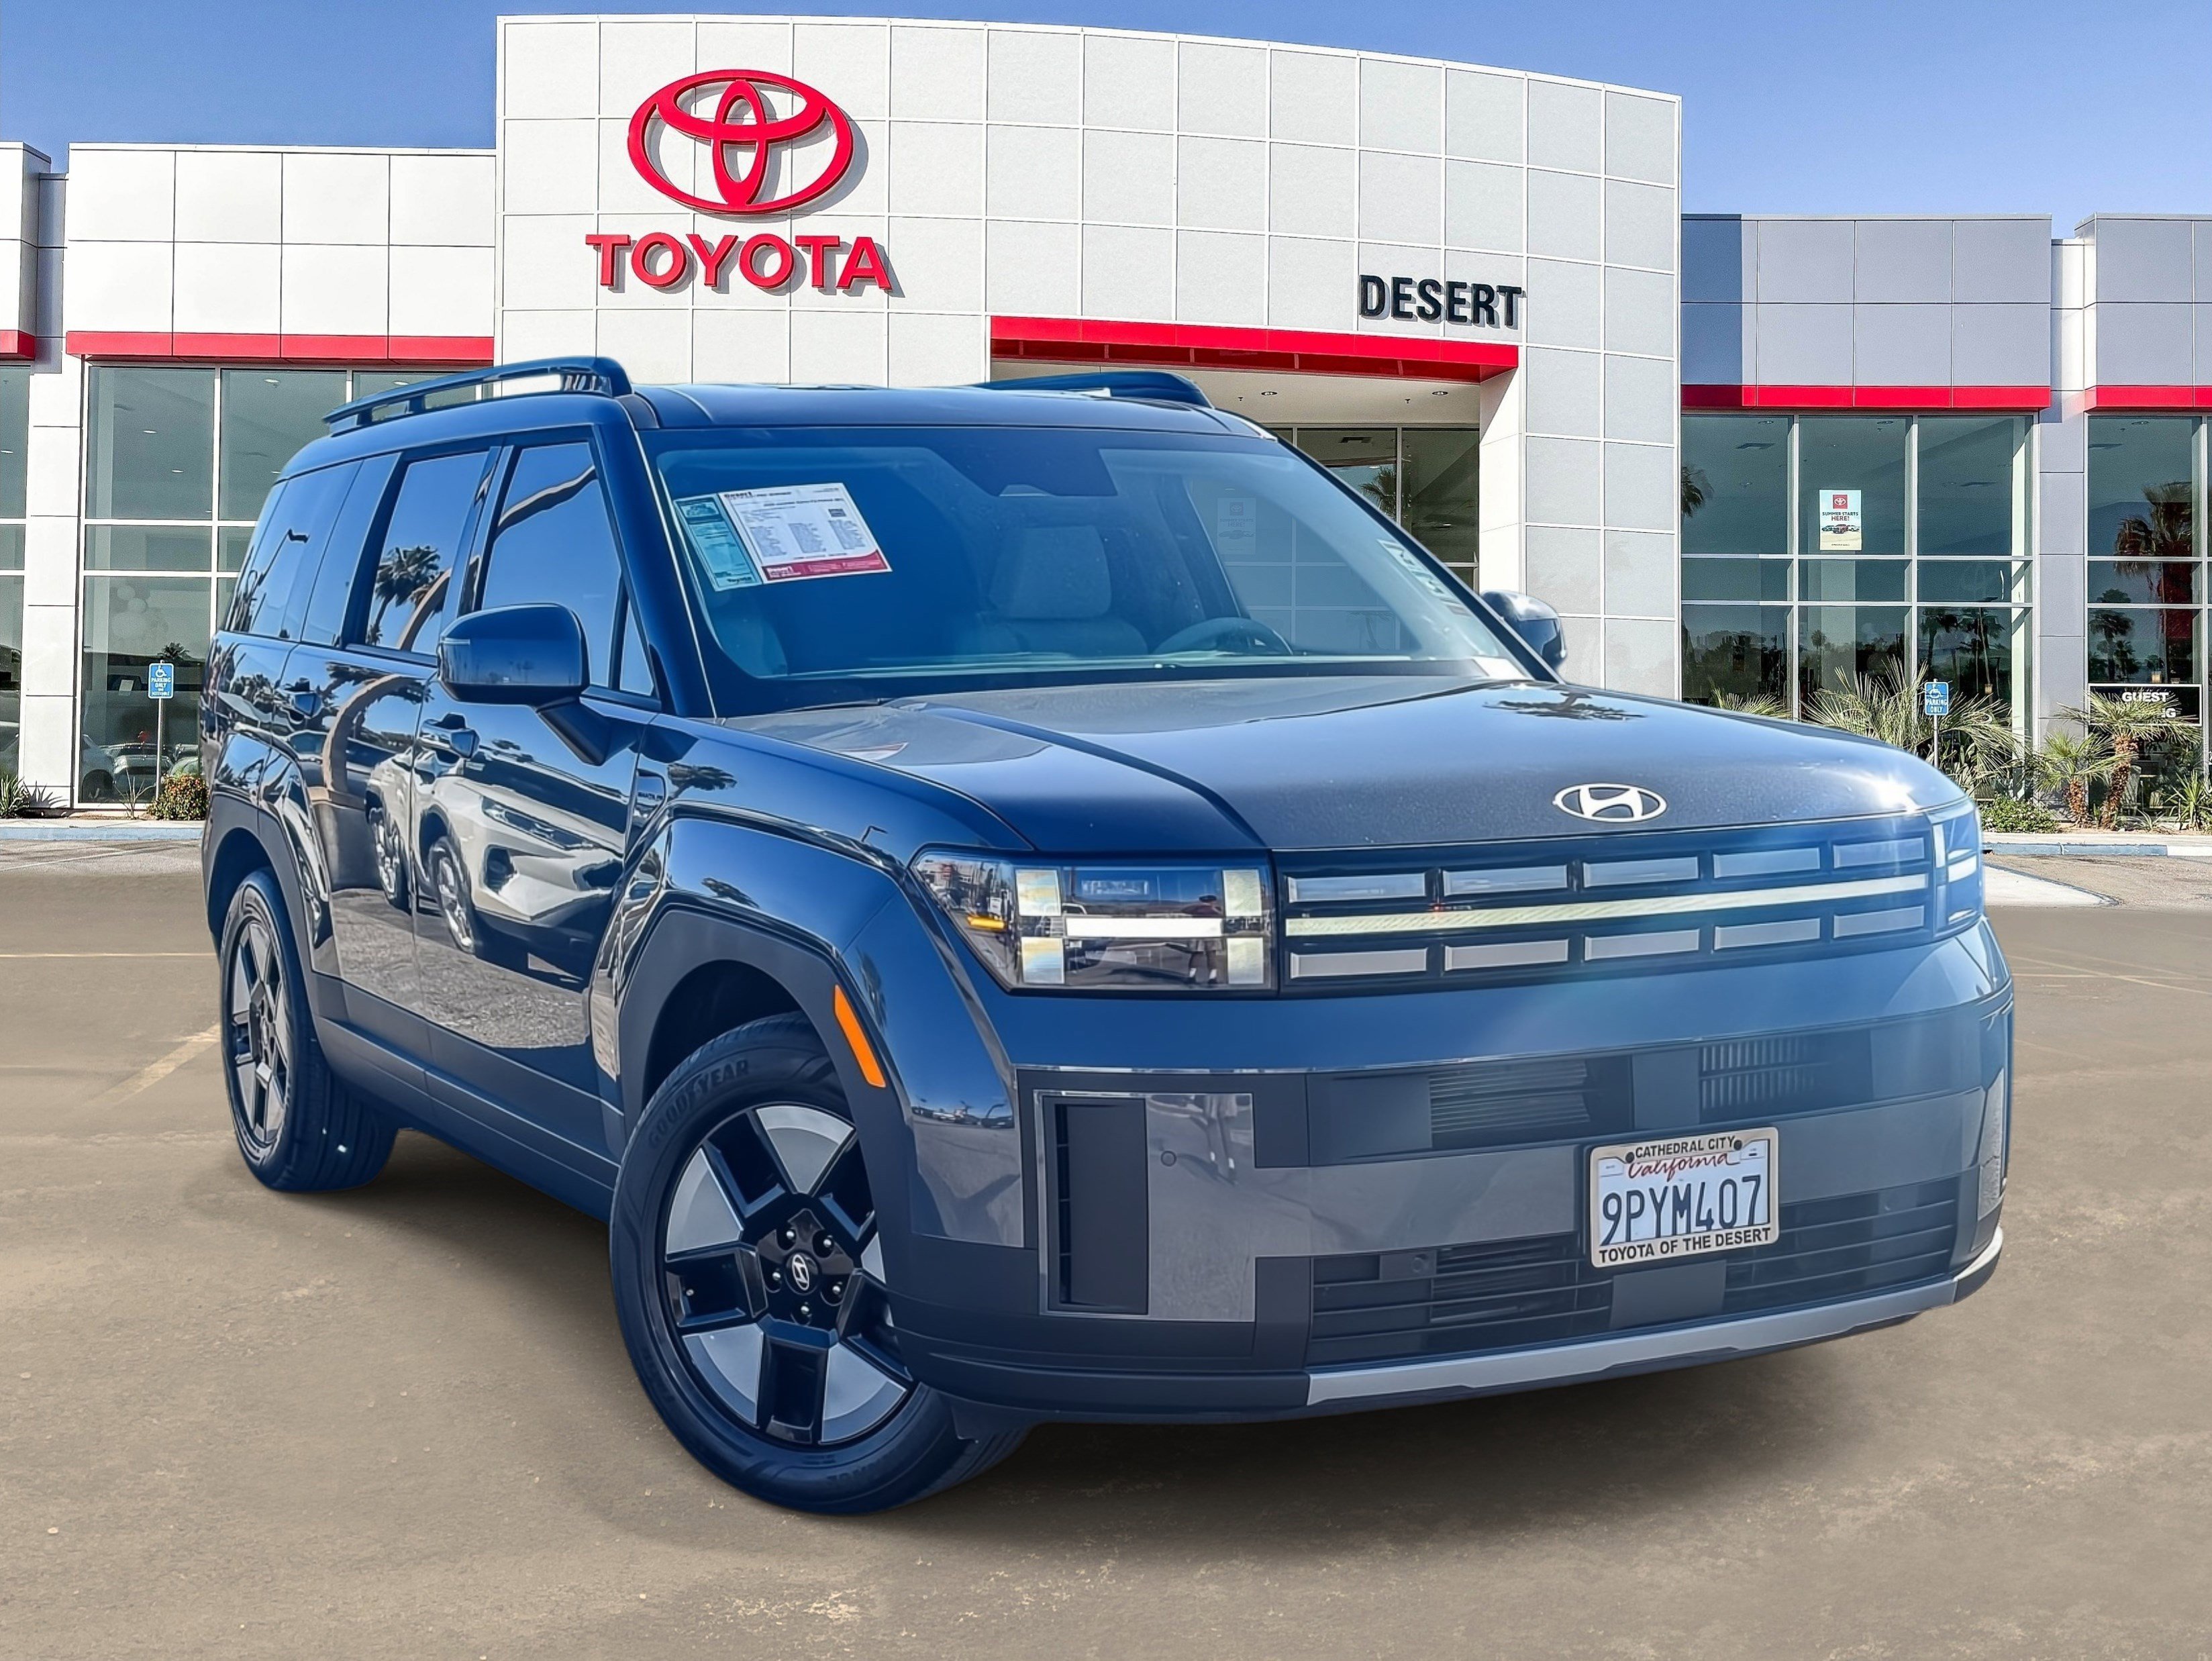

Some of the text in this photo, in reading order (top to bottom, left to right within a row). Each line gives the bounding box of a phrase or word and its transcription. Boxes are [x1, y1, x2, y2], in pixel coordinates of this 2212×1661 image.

[585, 232, 893, 291] TOYOTA
[1359, 274, 1522, 327] DESERT
[2121, 692, 2169, 703] GUEST
[1635, 1136, 1736, 1159] CATHEDRAL CITY
[1628, 1152, 1740, 1182] California
[1600, 1174, 1761, 1246] 9PYM407
[1599, 1227, 1771, 1263] TOYOTA OF THE DESERT
